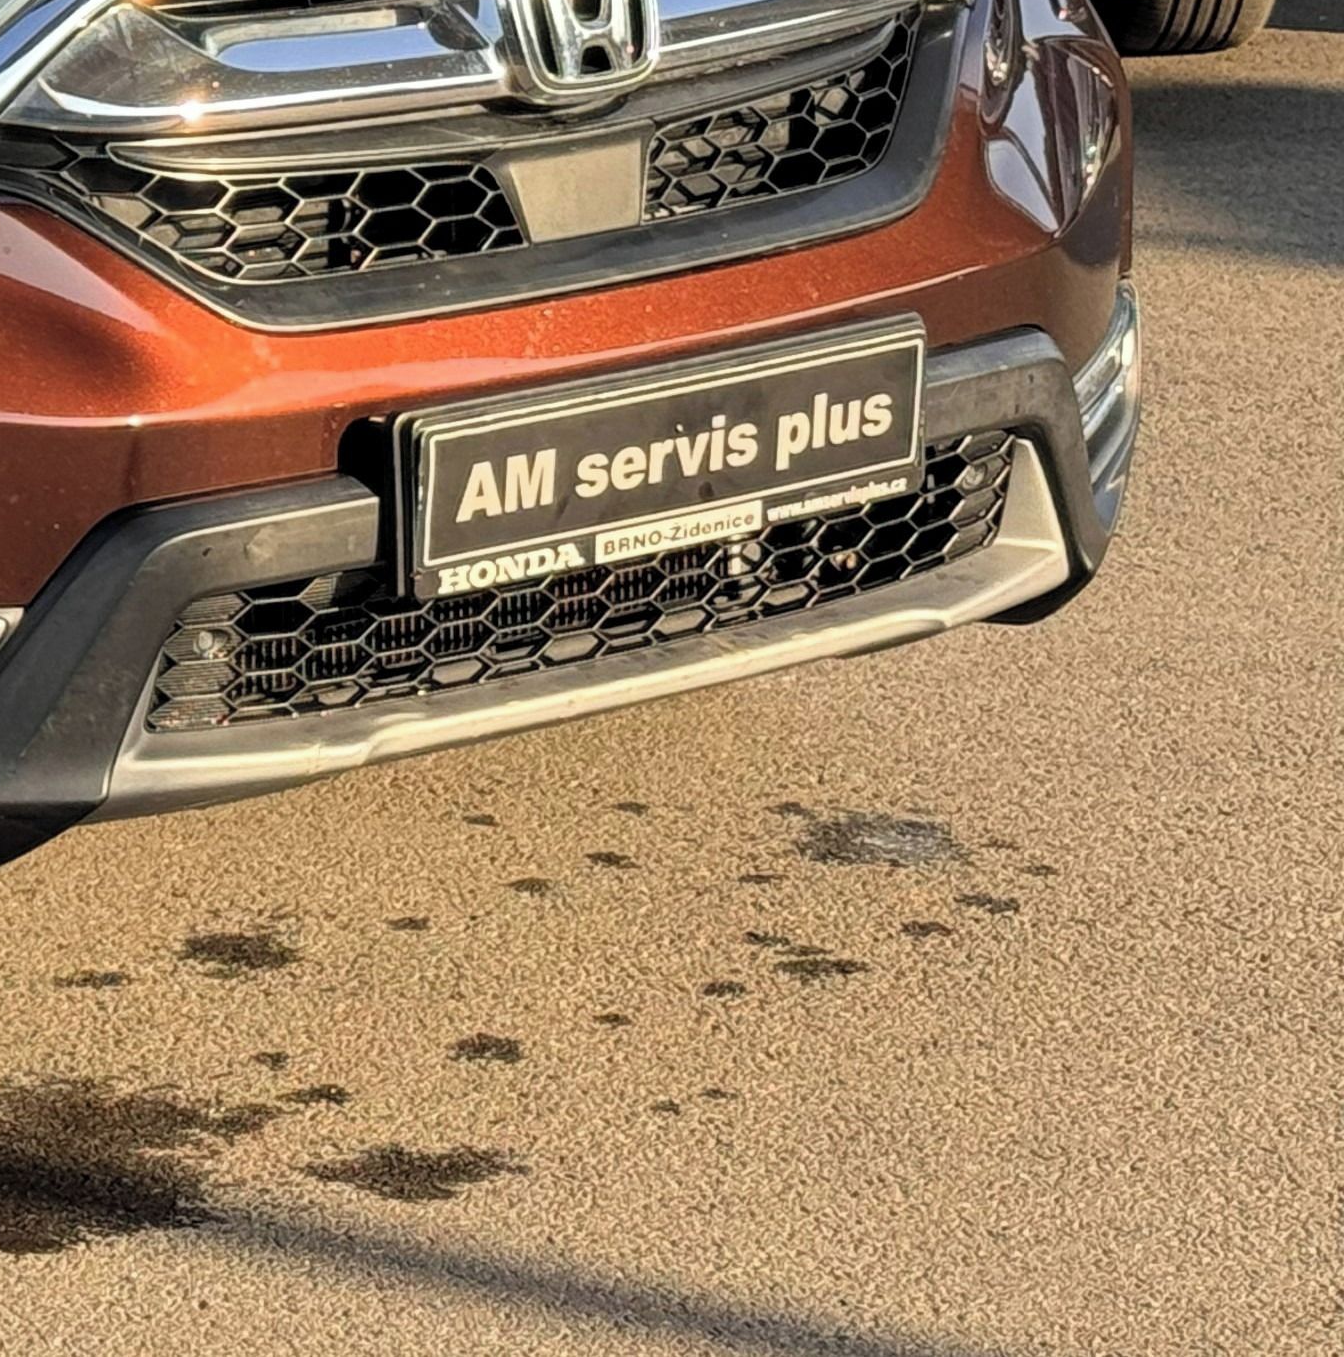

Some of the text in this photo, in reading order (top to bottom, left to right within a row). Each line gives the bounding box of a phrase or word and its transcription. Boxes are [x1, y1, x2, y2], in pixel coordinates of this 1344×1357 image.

[454, 390, 894, 524] AM servis plus
[437, 542, 586, 595] HONDA
